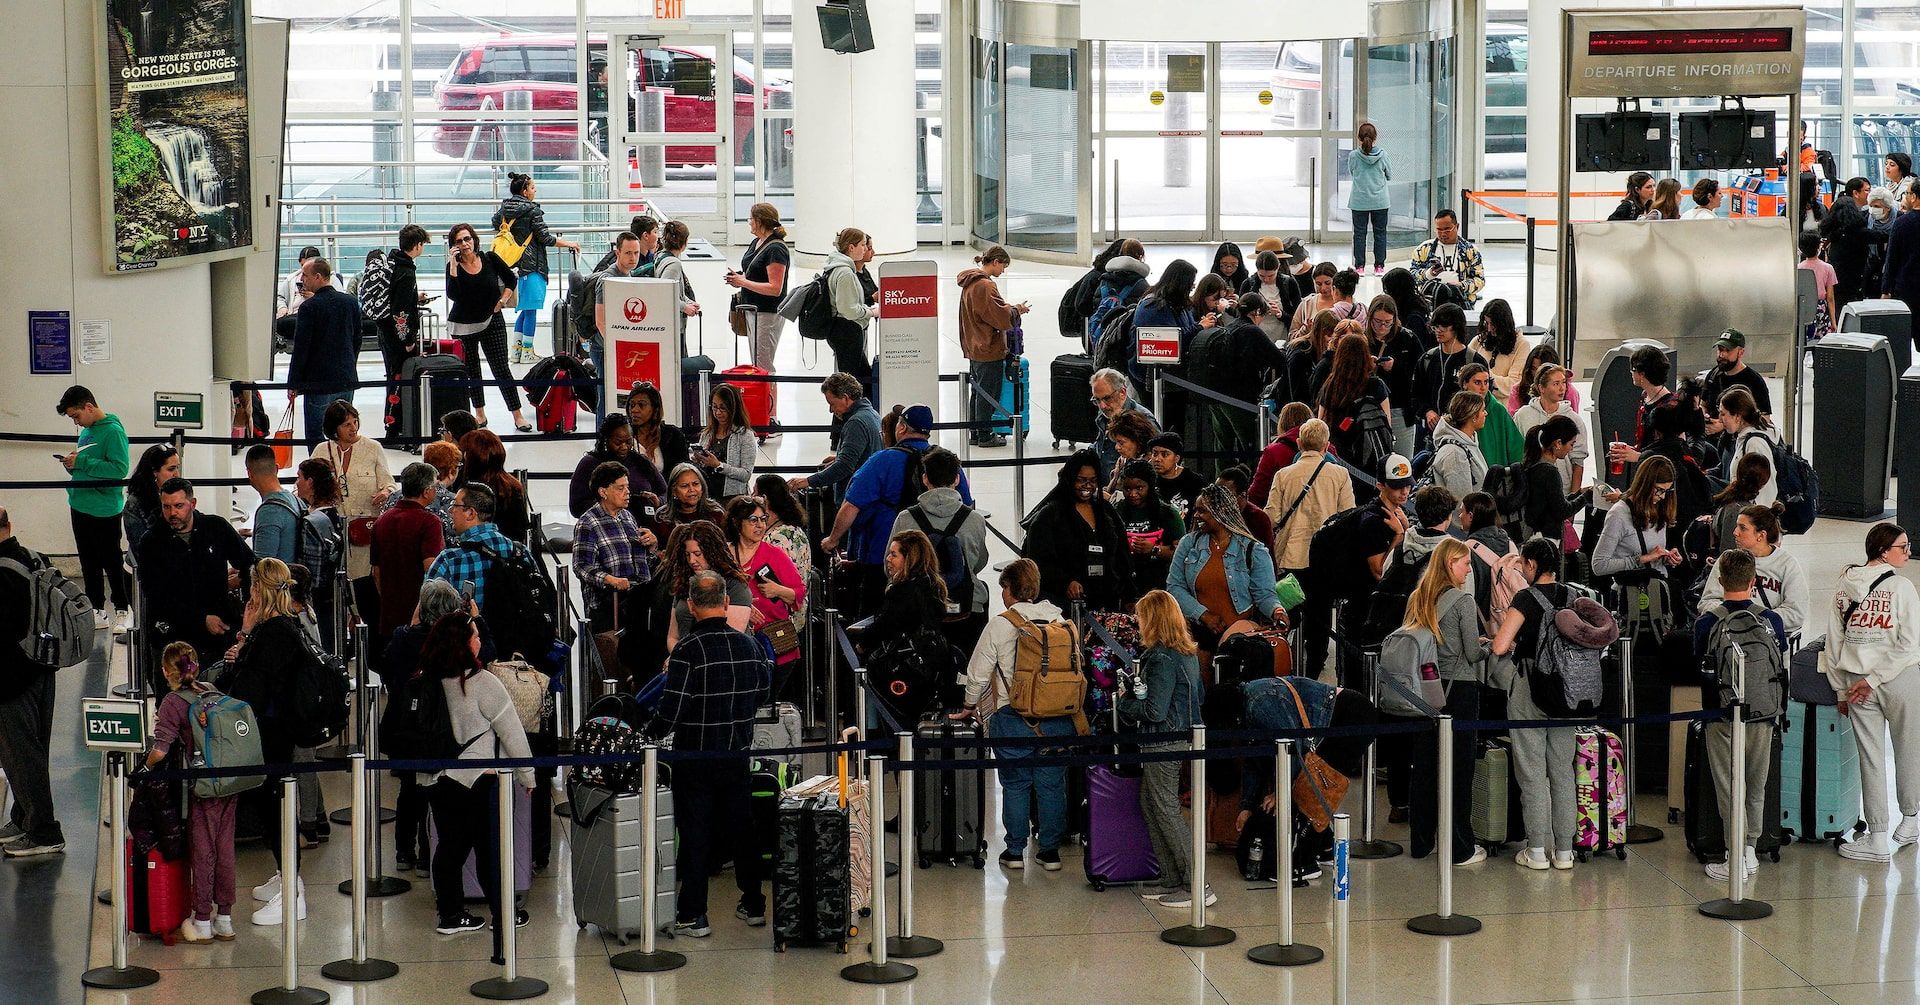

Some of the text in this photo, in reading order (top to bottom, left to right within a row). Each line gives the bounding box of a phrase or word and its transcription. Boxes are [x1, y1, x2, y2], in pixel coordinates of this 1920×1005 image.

[656, 0, 682, 18] EXIT
[139, 56, 157, 64] NEW
[159, 54, 180, 63] YORK
[180, 52, 203, 61] STATE
[212, 49, 225, 57] FOR
[121, 56, 238, 78] GORGEOUS GORGES.
[1584, 63, 1792, 78] DEPARTURE INFORMATION
[189, 225, 208, 238] NY
[160, 406, 185, 416] EXIT
[90, 720, 121, 734] EXIT
